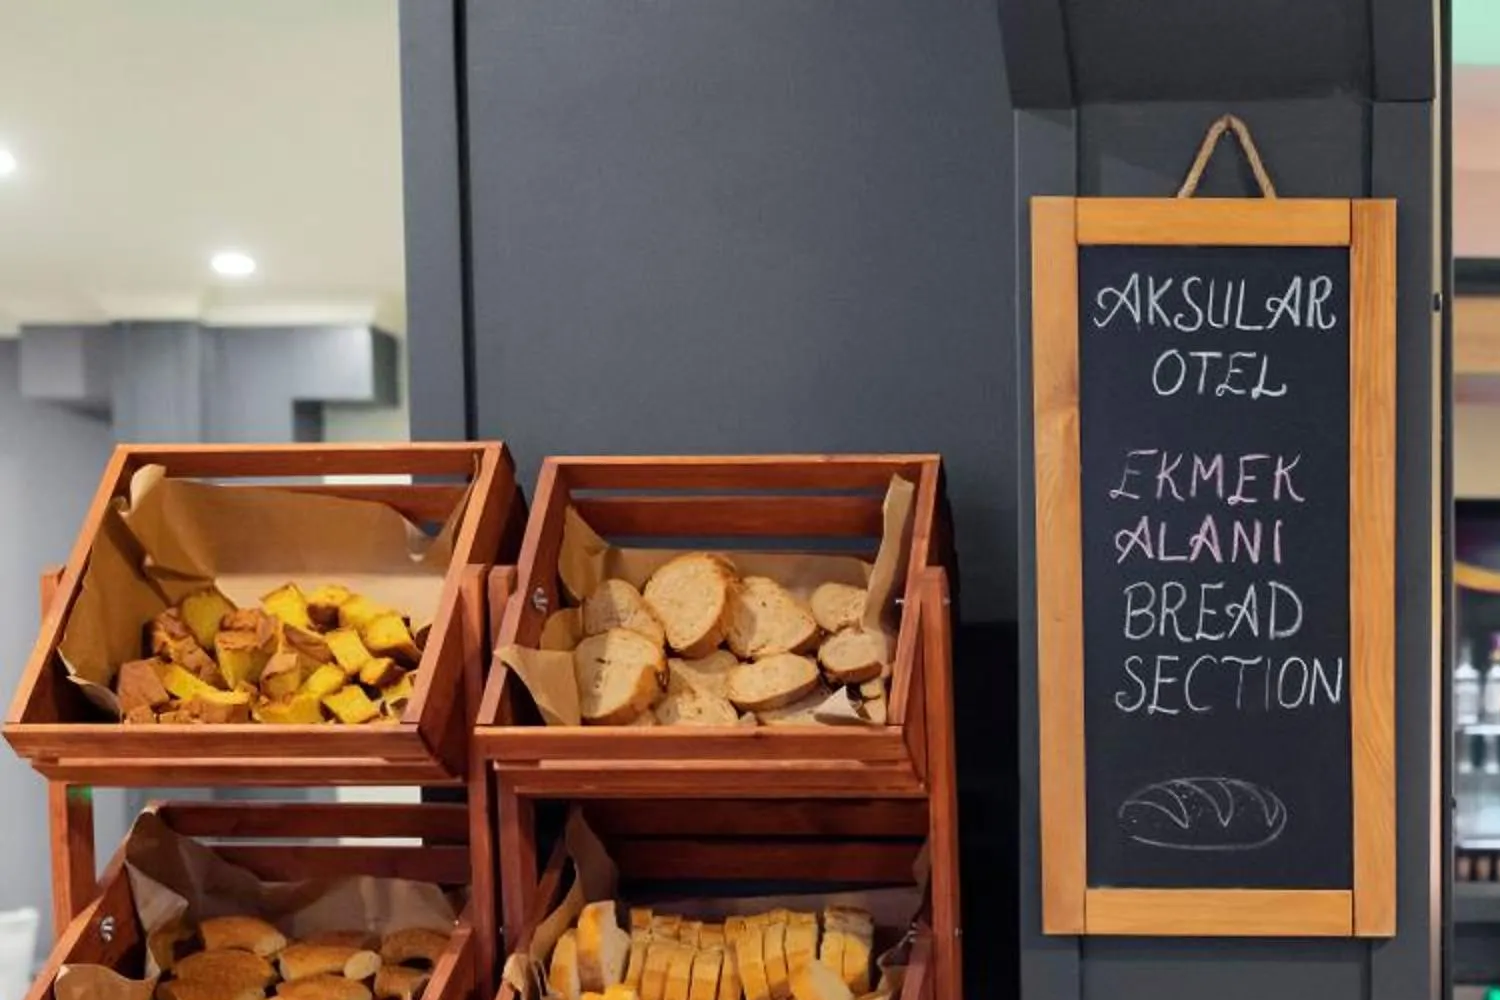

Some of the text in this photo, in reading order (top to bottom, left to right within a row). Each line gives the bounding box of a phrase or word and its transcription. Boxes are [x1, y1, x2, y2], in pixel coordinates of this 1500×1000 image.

[1094, 273, 1337, 332] AKSULAR
[1152, 349, 1287, 398] OTEL
[1109, 450, 1306, 505] EKMEK
[1114, 515, 1284, 564] ALANI
[1123, 581, 1304, 643] BREAD
[1114, 655, 1344, 713] SECTION
